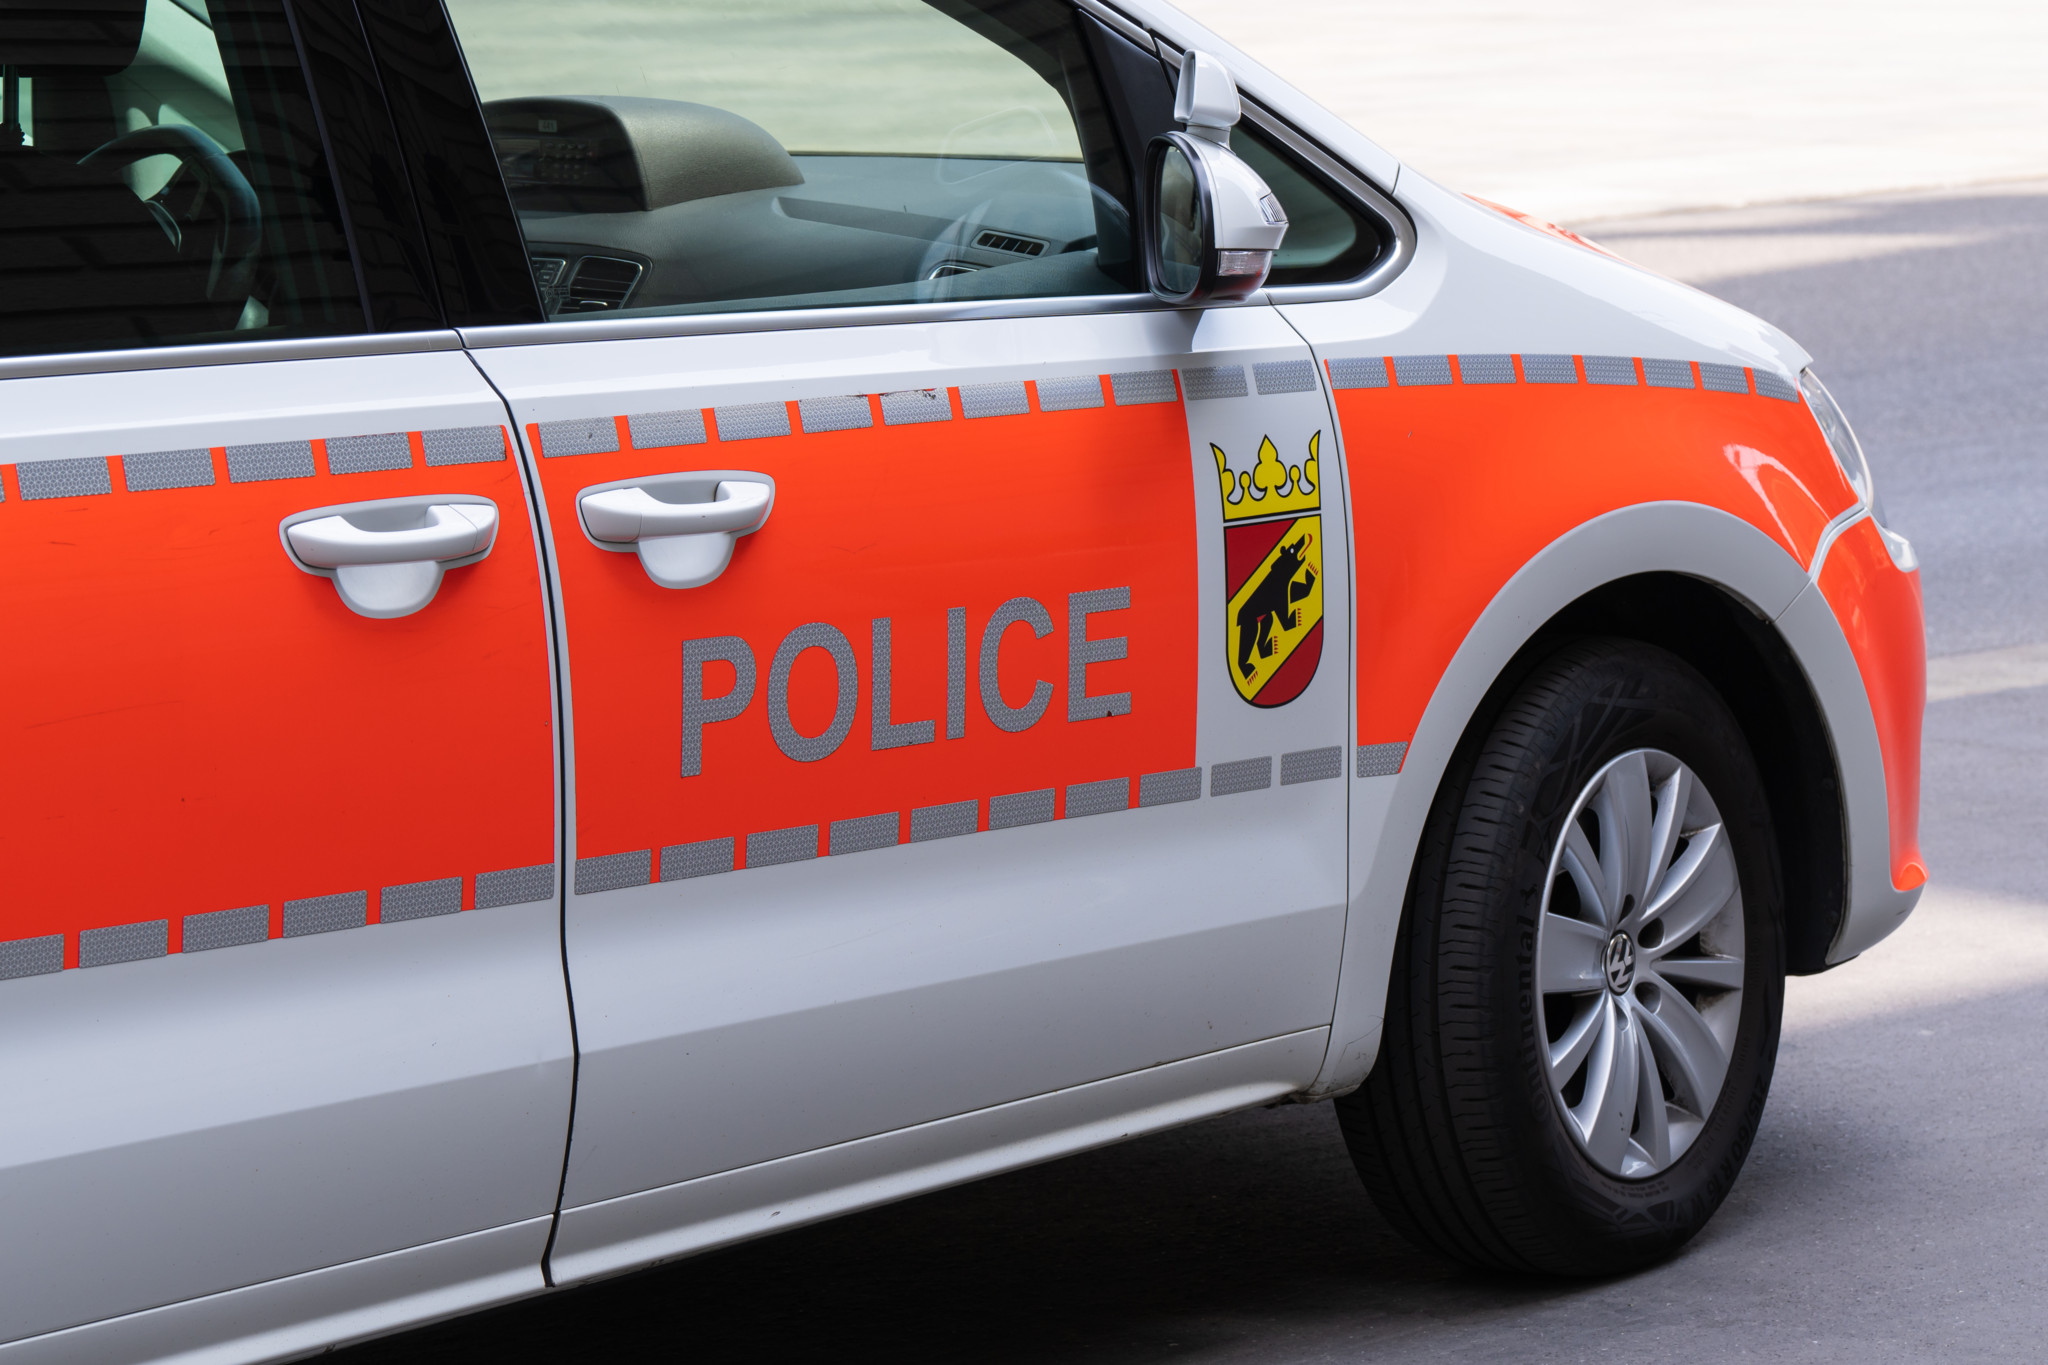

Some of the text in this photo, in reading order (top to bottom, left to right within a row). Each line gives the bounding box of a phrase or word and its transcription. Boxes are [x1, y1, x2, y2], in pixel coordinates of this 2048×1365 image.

[681, 586, 1132, 778] POLICE
[1516, 914, 1550, 1124] Continental
[1731, 1073, 1768, 1161] 215/60
